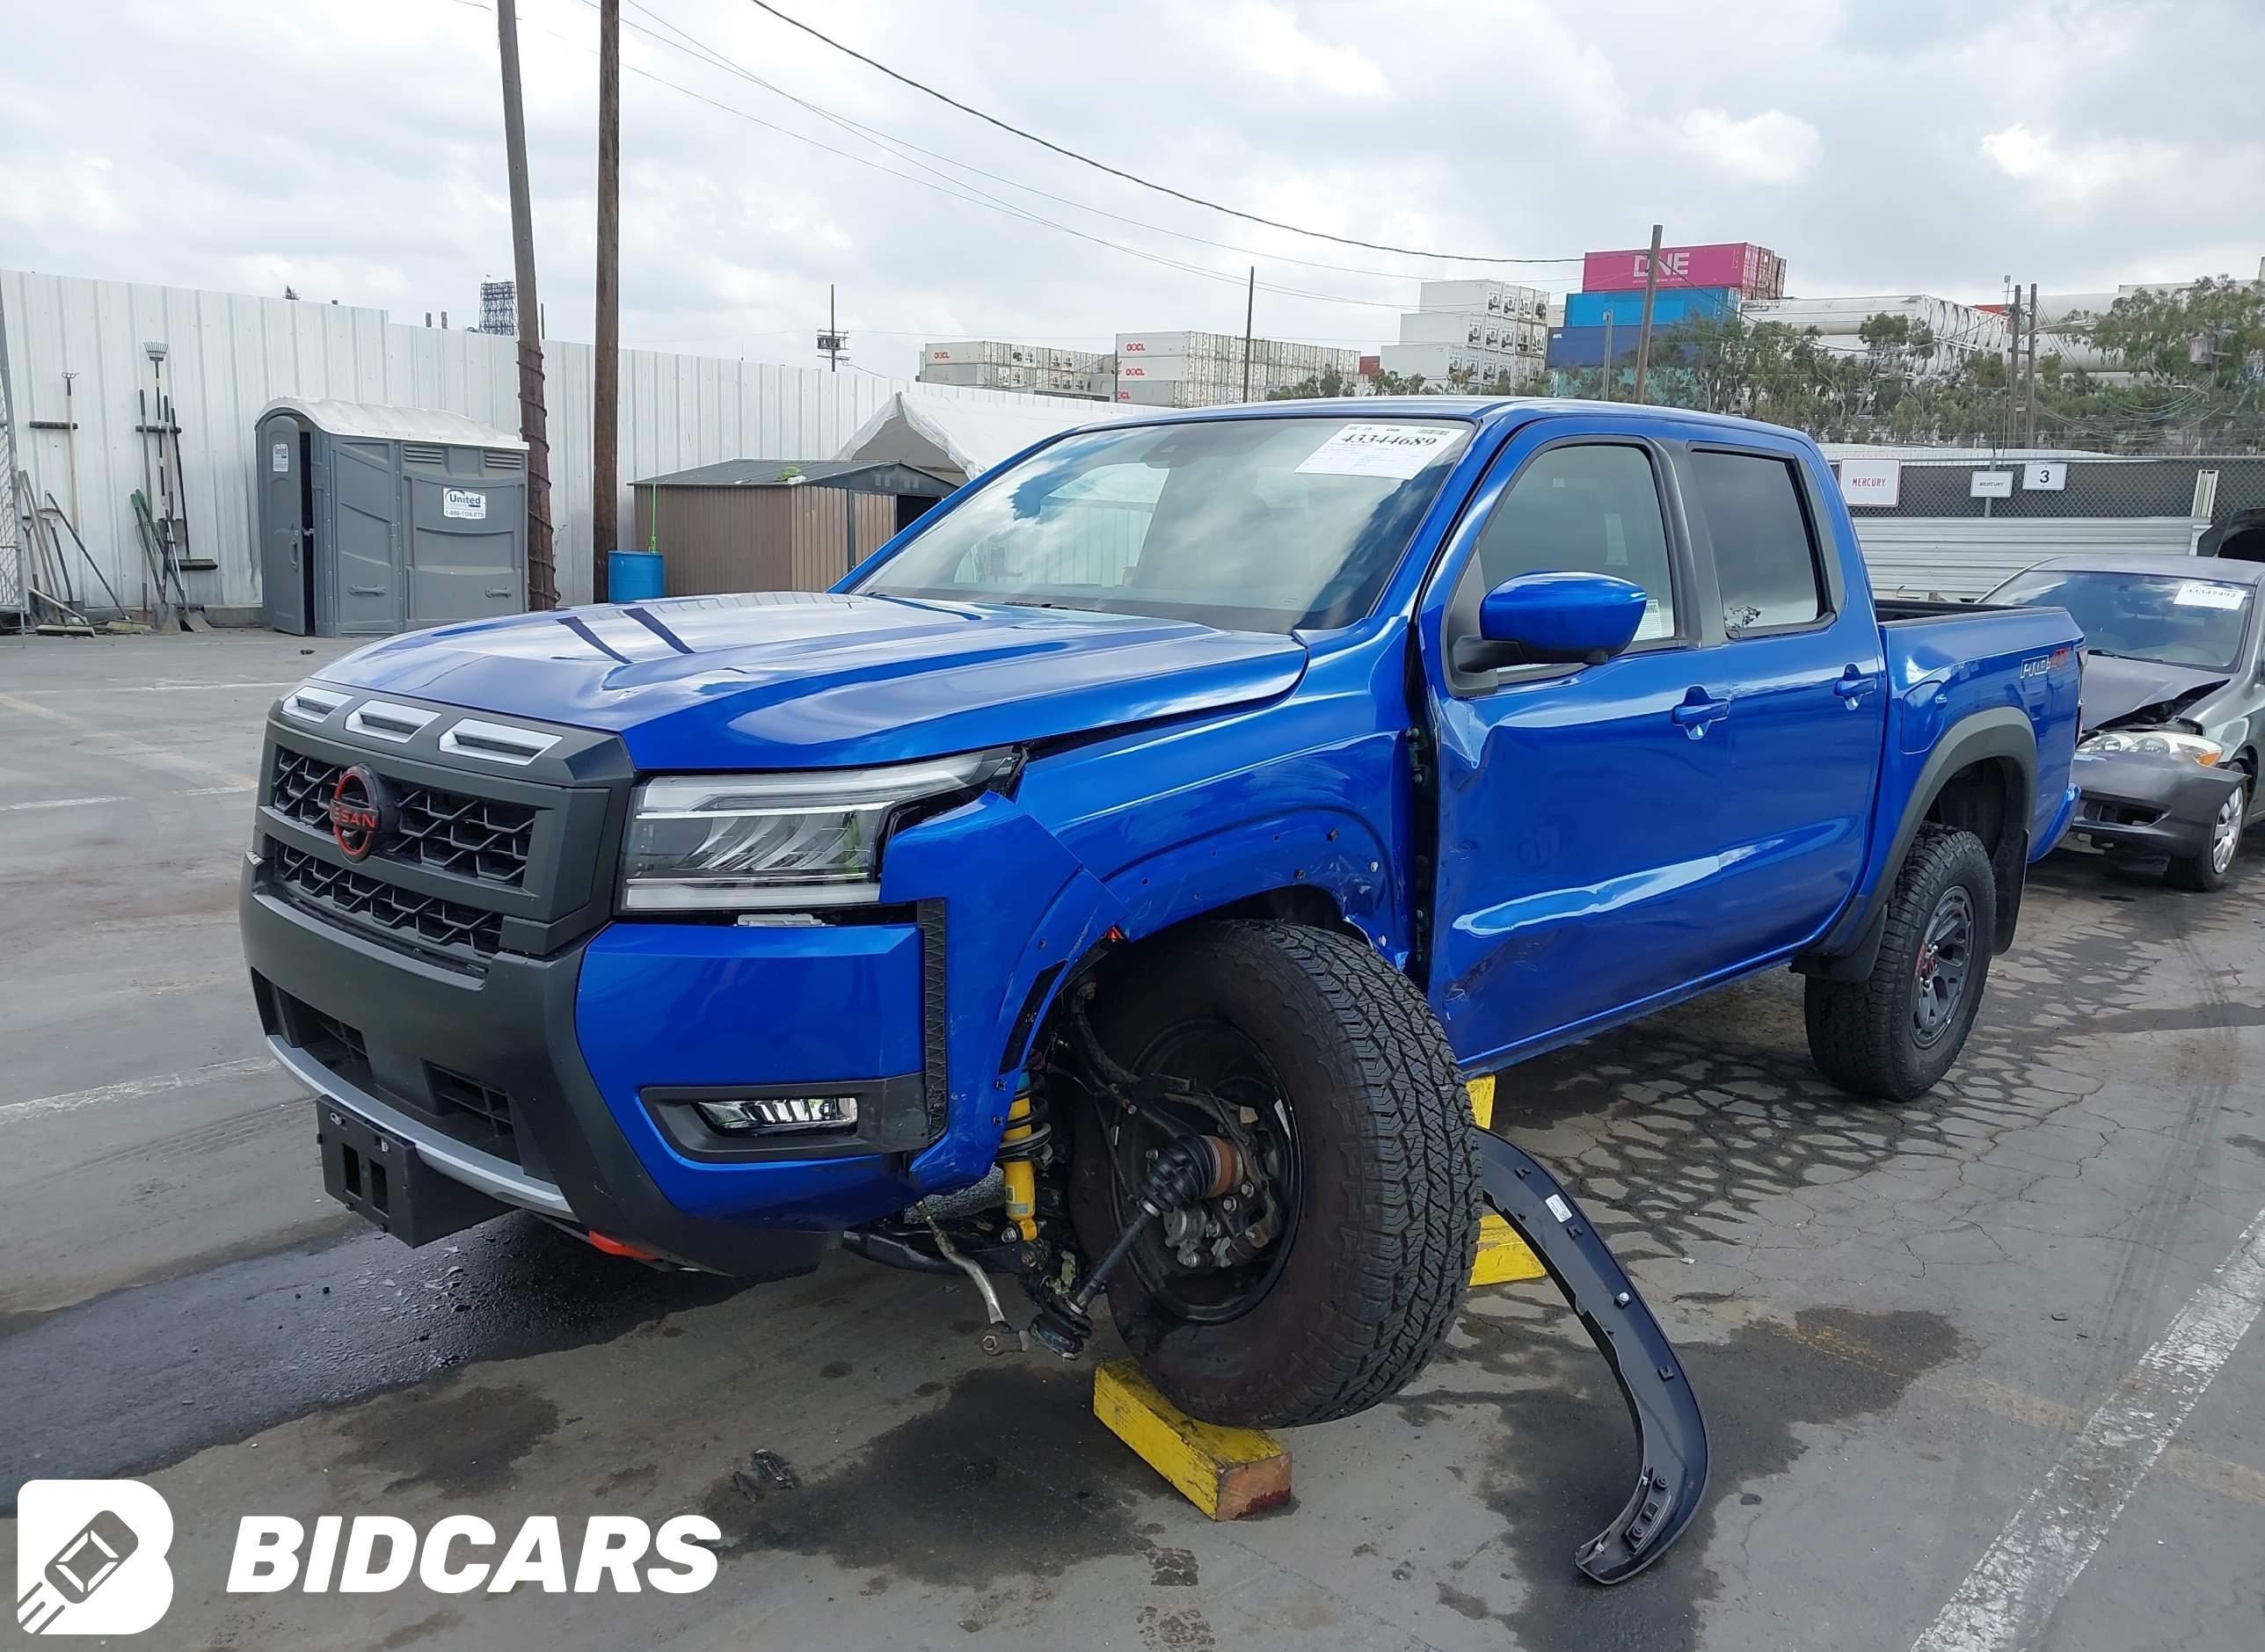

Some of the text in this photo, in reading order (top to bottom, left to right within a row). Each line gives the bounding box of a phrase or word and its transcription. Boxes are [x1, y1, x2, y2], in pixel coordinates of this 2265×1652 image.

[1125, 343, 1146, 352] OOCL
[1125, 368, 1145, 376] OOCL
[1341, 433, 1438, 447] 43344689
[1852, 477, 1886, 487] MERCURY
[2039, 469, 2050, 484] 3
[449, 493, 481, 505] United
